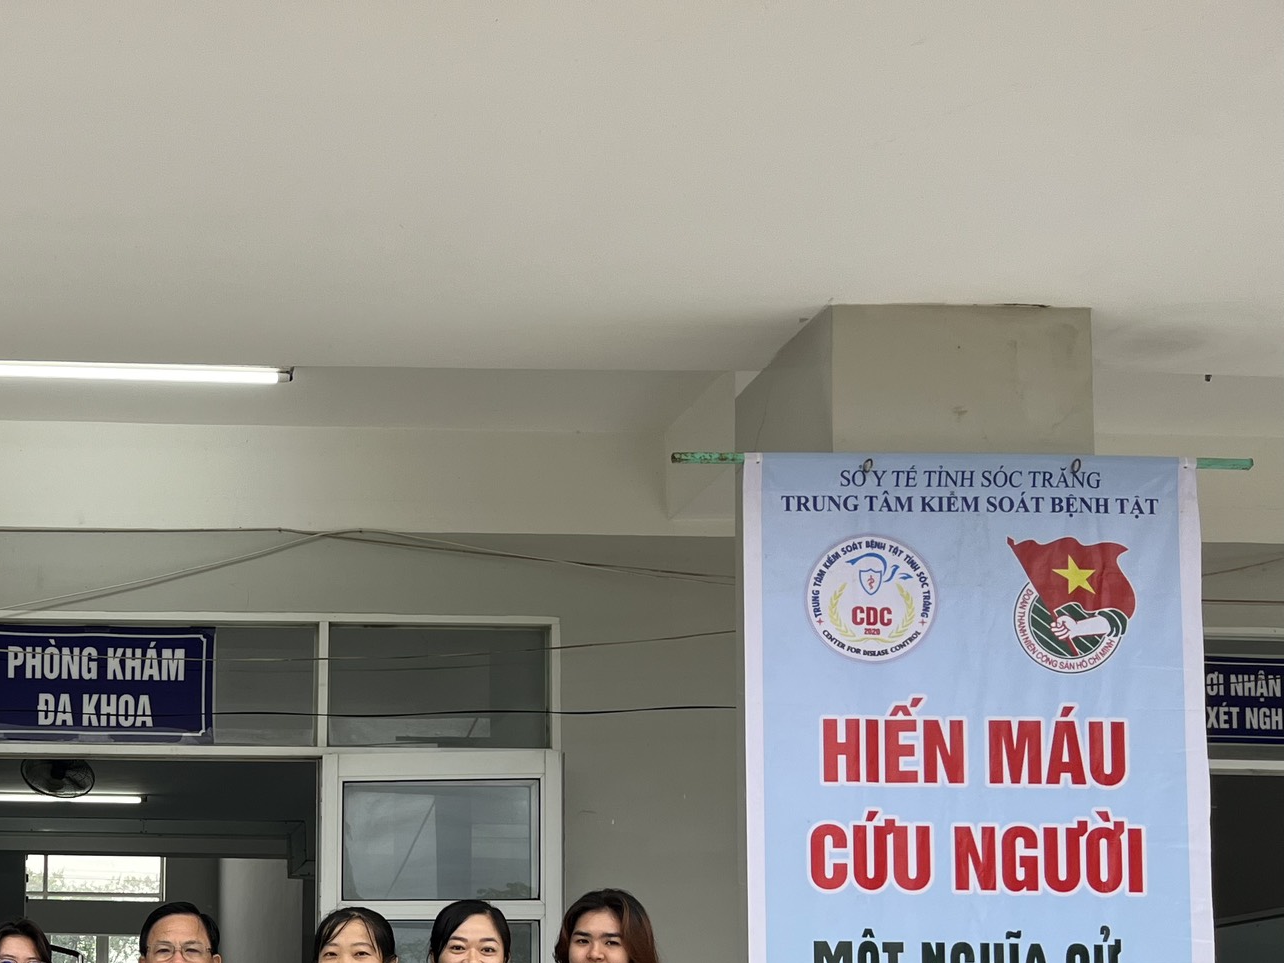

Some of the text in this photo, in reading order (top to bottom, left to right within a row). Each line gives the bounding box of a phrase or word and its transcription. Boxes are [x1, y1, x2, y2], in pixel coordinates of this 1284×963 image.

[840, 465, 1101, 489] SỞ Y TẾ TỈNH SÓC TRĂNG
[781, 490, 1158, 519] TRUNG TÂM KIỂM SOÁT BỆNH TẬT
[812, 590, 822, 618] TRUNG
[841, 541, 863, 555] SOÁT
[851, 606, 893, 627] CDC
[822, 629, 846, 650] CENTER
[846, 645, 862, 655] FOR
[890, 631, 922, 653] CONTROL
[1100, 640, 1116, 658] MINH
[7, 638, 186, 681] PHÒNG KHÁM
[1206, 670, 1281, 702] ƠI NHẬN
[37, 693, 153, 727] ĐA KHOA
[1206, 701, 1283, 730] XÉT NGH
[822, 697, 1126, 786] HIẾN MÁU
[810, 810, 1144, 893] CỨU NGƯỜI
